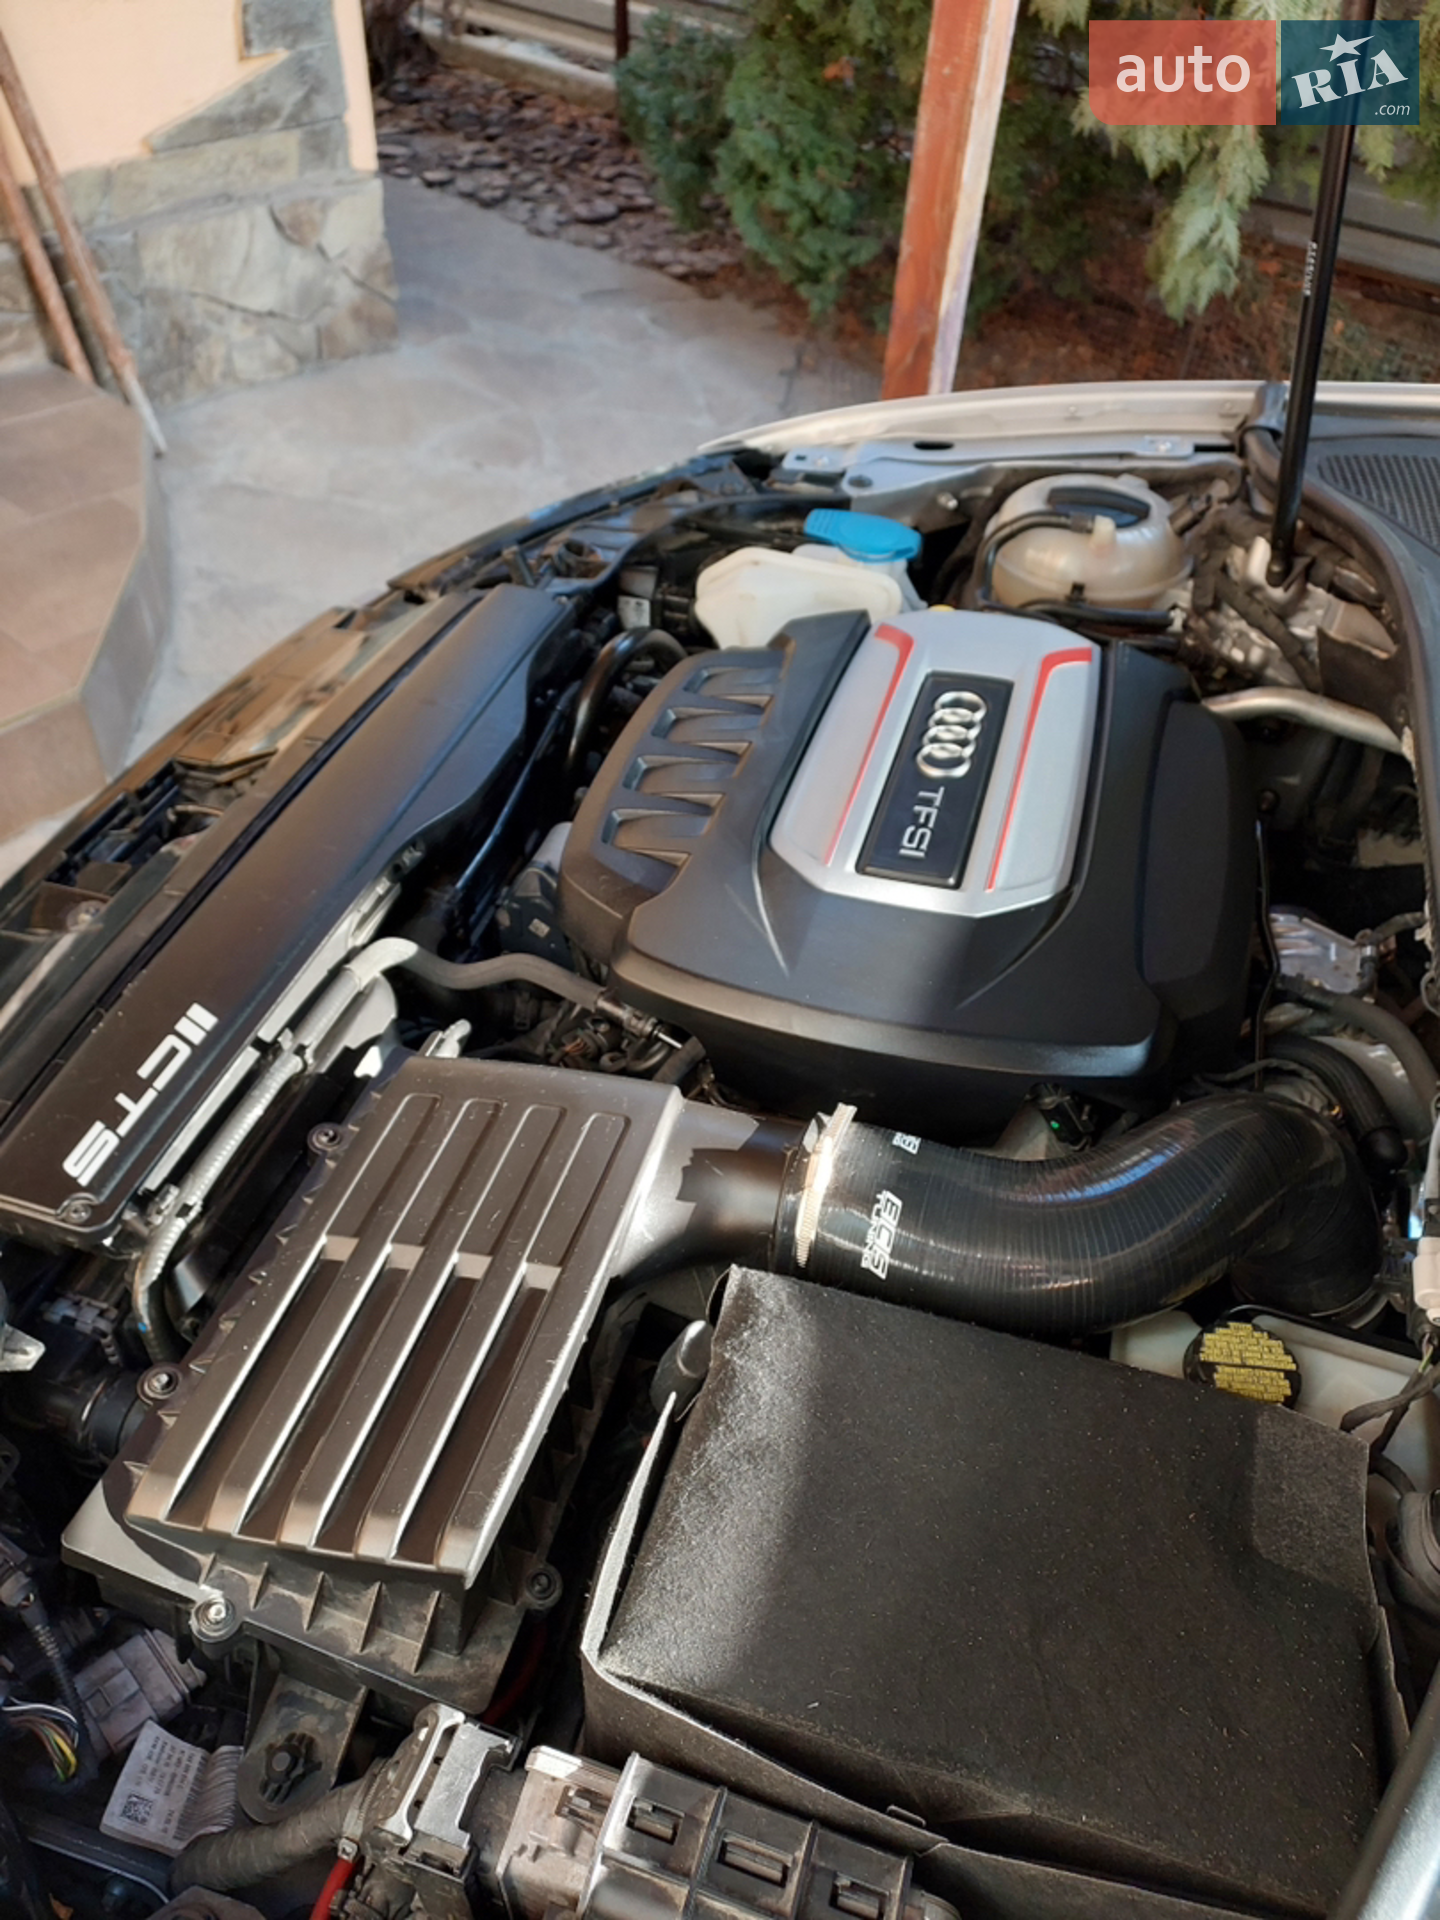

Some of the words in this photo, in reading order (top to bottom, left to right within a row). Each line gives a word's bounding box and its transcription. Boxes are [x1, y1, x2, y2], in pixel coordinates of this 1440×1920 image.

[899, 786, 945, 858] TFSI
[860, 1189, 885, 1268] TUNING
[868, 1190, 903, 1280] ECS
